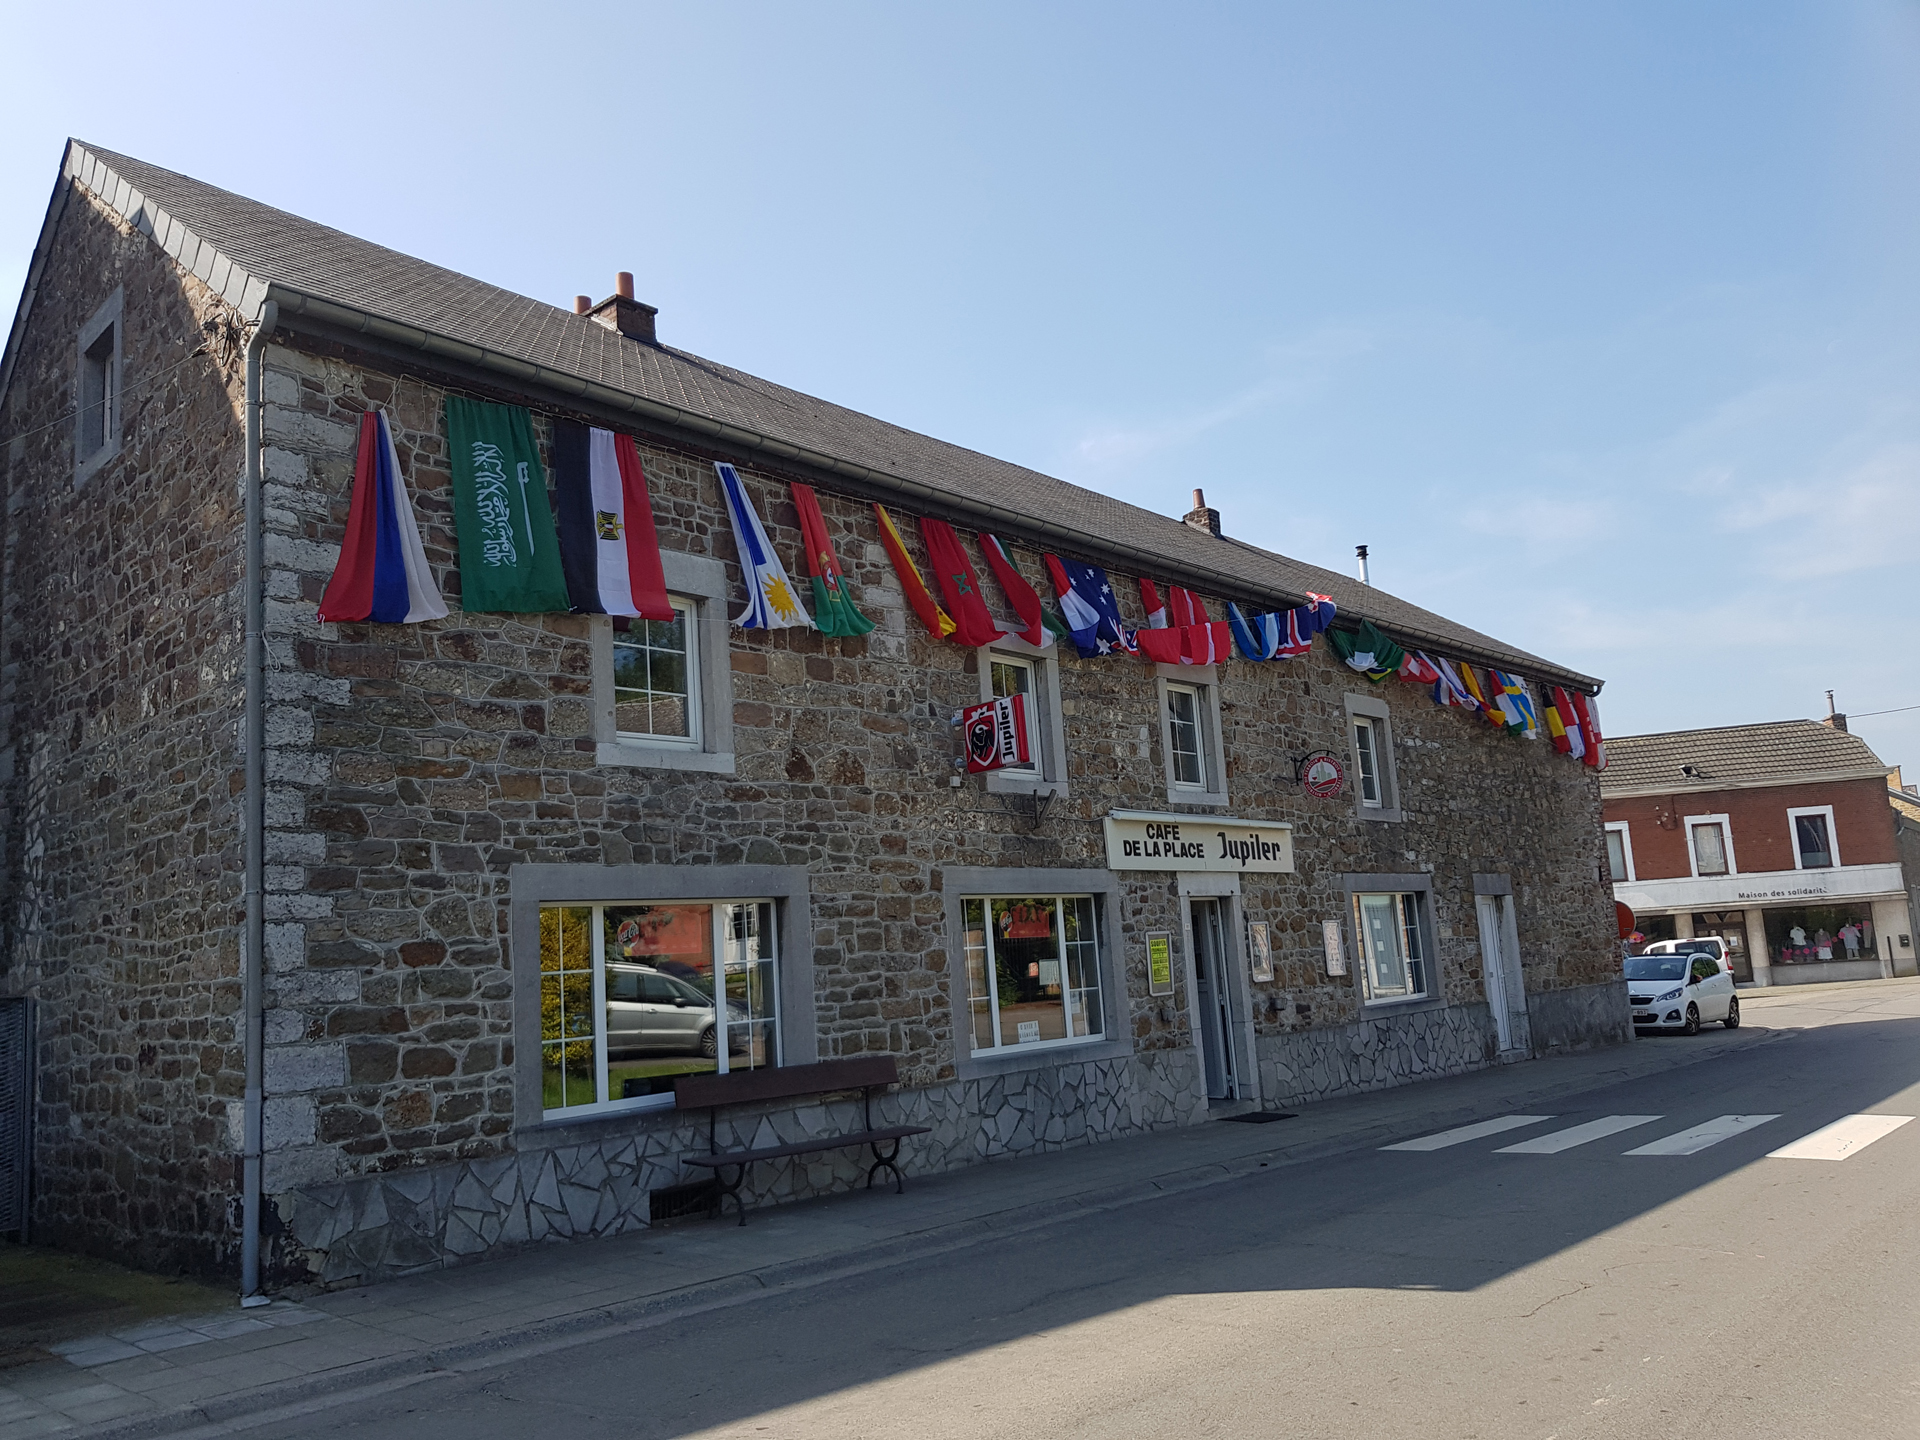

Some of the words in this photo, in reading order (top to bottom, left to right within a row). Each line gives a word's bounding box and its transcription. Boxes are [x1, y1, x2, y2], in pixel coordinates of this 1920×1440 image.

[999, 701, 1016, 760] Jupiler
[1146, 823, 1181, 840] CAFE
[1123, 840, 1142, 857] DE
[1144, 841, 1162, 857] LA
[1164, 841, 1205, 858] PLACE
[1217, 831, 1281, 867] Jupiler
[1738, 891, 1768, 899] Maison
